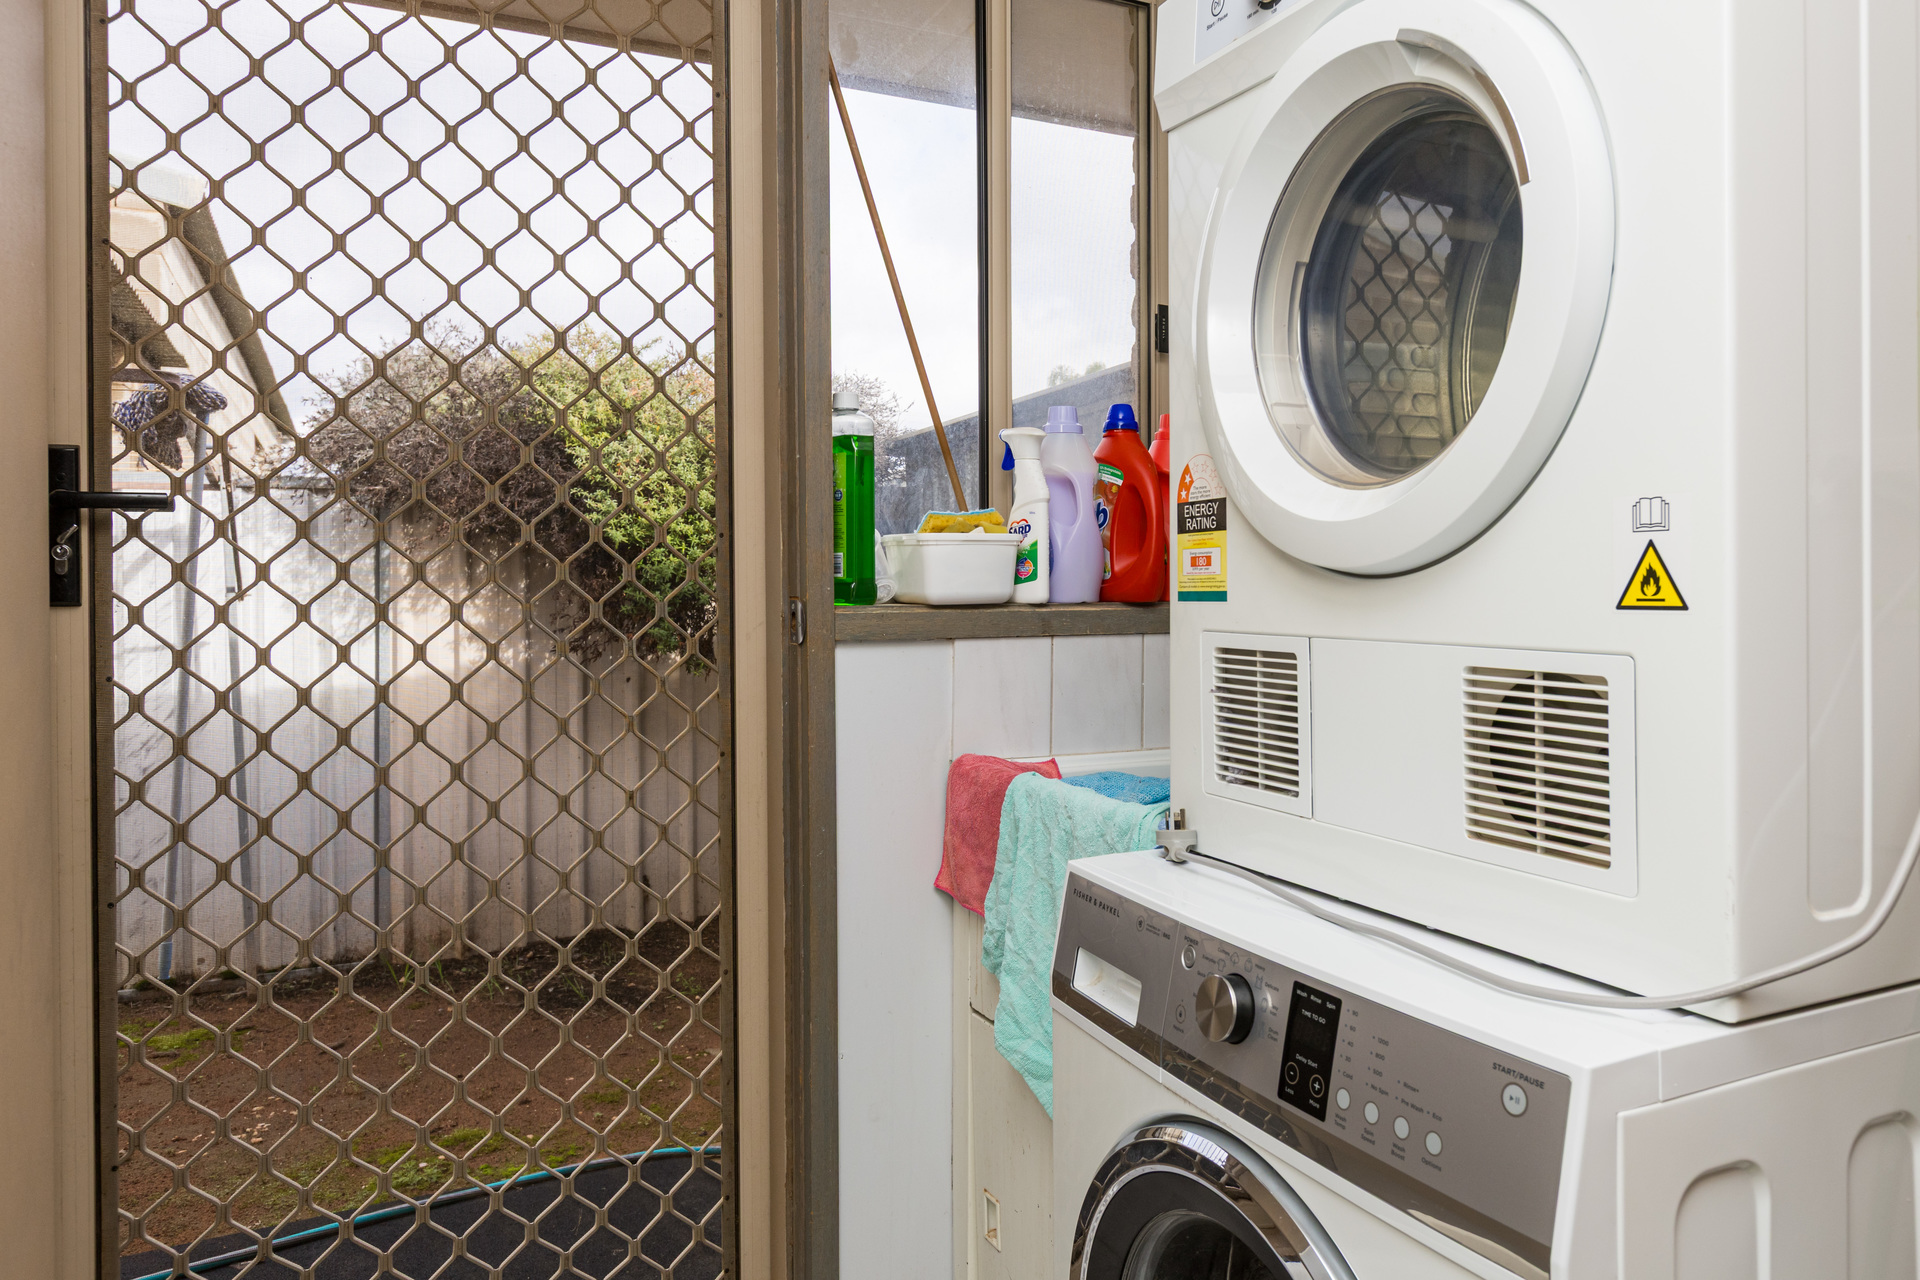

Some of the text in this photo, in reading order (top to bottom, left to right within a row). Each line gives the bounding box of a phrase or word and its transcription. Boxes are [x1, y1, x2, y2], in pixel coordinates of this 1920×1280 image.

[1184, 501, 1219, 518] ENERGY
[1186, 516, 1217, 530] RATING
[1196, 556, 1207, 566] 180
[1073, 888, 1092, 904] FISHER
[1098, 901, 1120, 918] PAYKEL
[1184, 935, 1199, 946] POWER
[1265, 981, 1280, 992] Delicate
[1326, 1001, 1336, 1010] Spin
[1301, 1008, 1326, 1025] TIME TO GO
[1377, 1037, 1389, 1046] 1200
[1295, 1053, 1318, 1069] Delay Start
[1342, 1071, 1354, 1080] Cold
[1492, 1062, 1545, 1090] START/PAUSE
[1378, 1087, 1389, 1096] Spin
[1308, 1099, 1320, 1109] More
[1400, 1098, 1424, 1113] Pre Wash
[1432, 1112, 1443, 1122] Eco
[1364, 1127, 1374, 1137] Spin
[1361, 1133, 1376, 1145] Speed
[1392, 1142, 1406, 1153] Wash
[1391, 1149, 1406, 1161] Boost
[1421, 1157, 1442, 1172] Options
